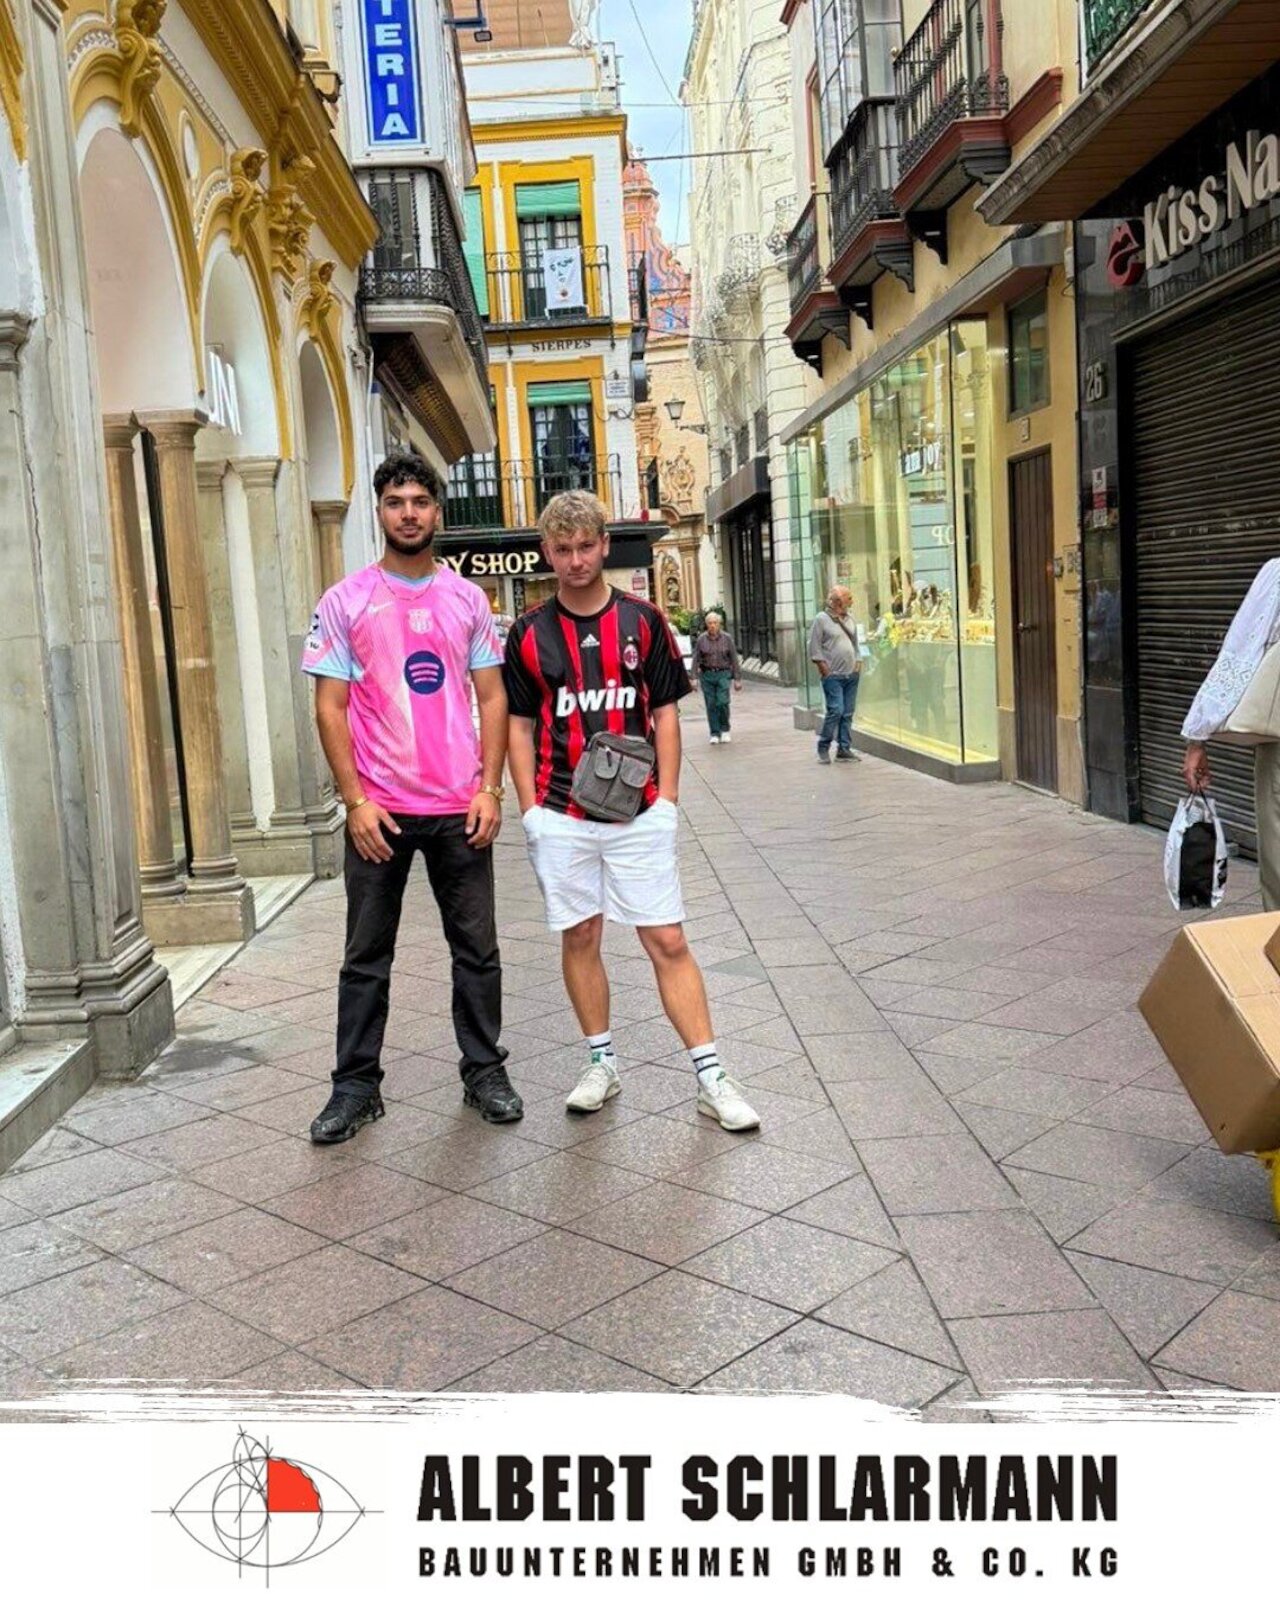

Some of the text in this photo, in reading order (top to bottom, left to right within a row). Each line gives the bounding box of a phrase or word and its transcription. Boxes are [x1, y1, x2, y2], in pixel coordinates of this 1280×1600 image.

[1143, 129, 1280, 271] Kiss Na
[532, 339, 592, 353] SIERPES
[1085, 362, 1104, 402] 26
[471, 551, 540, 576] SHOP
[556, 679, 636, 717] bwin
